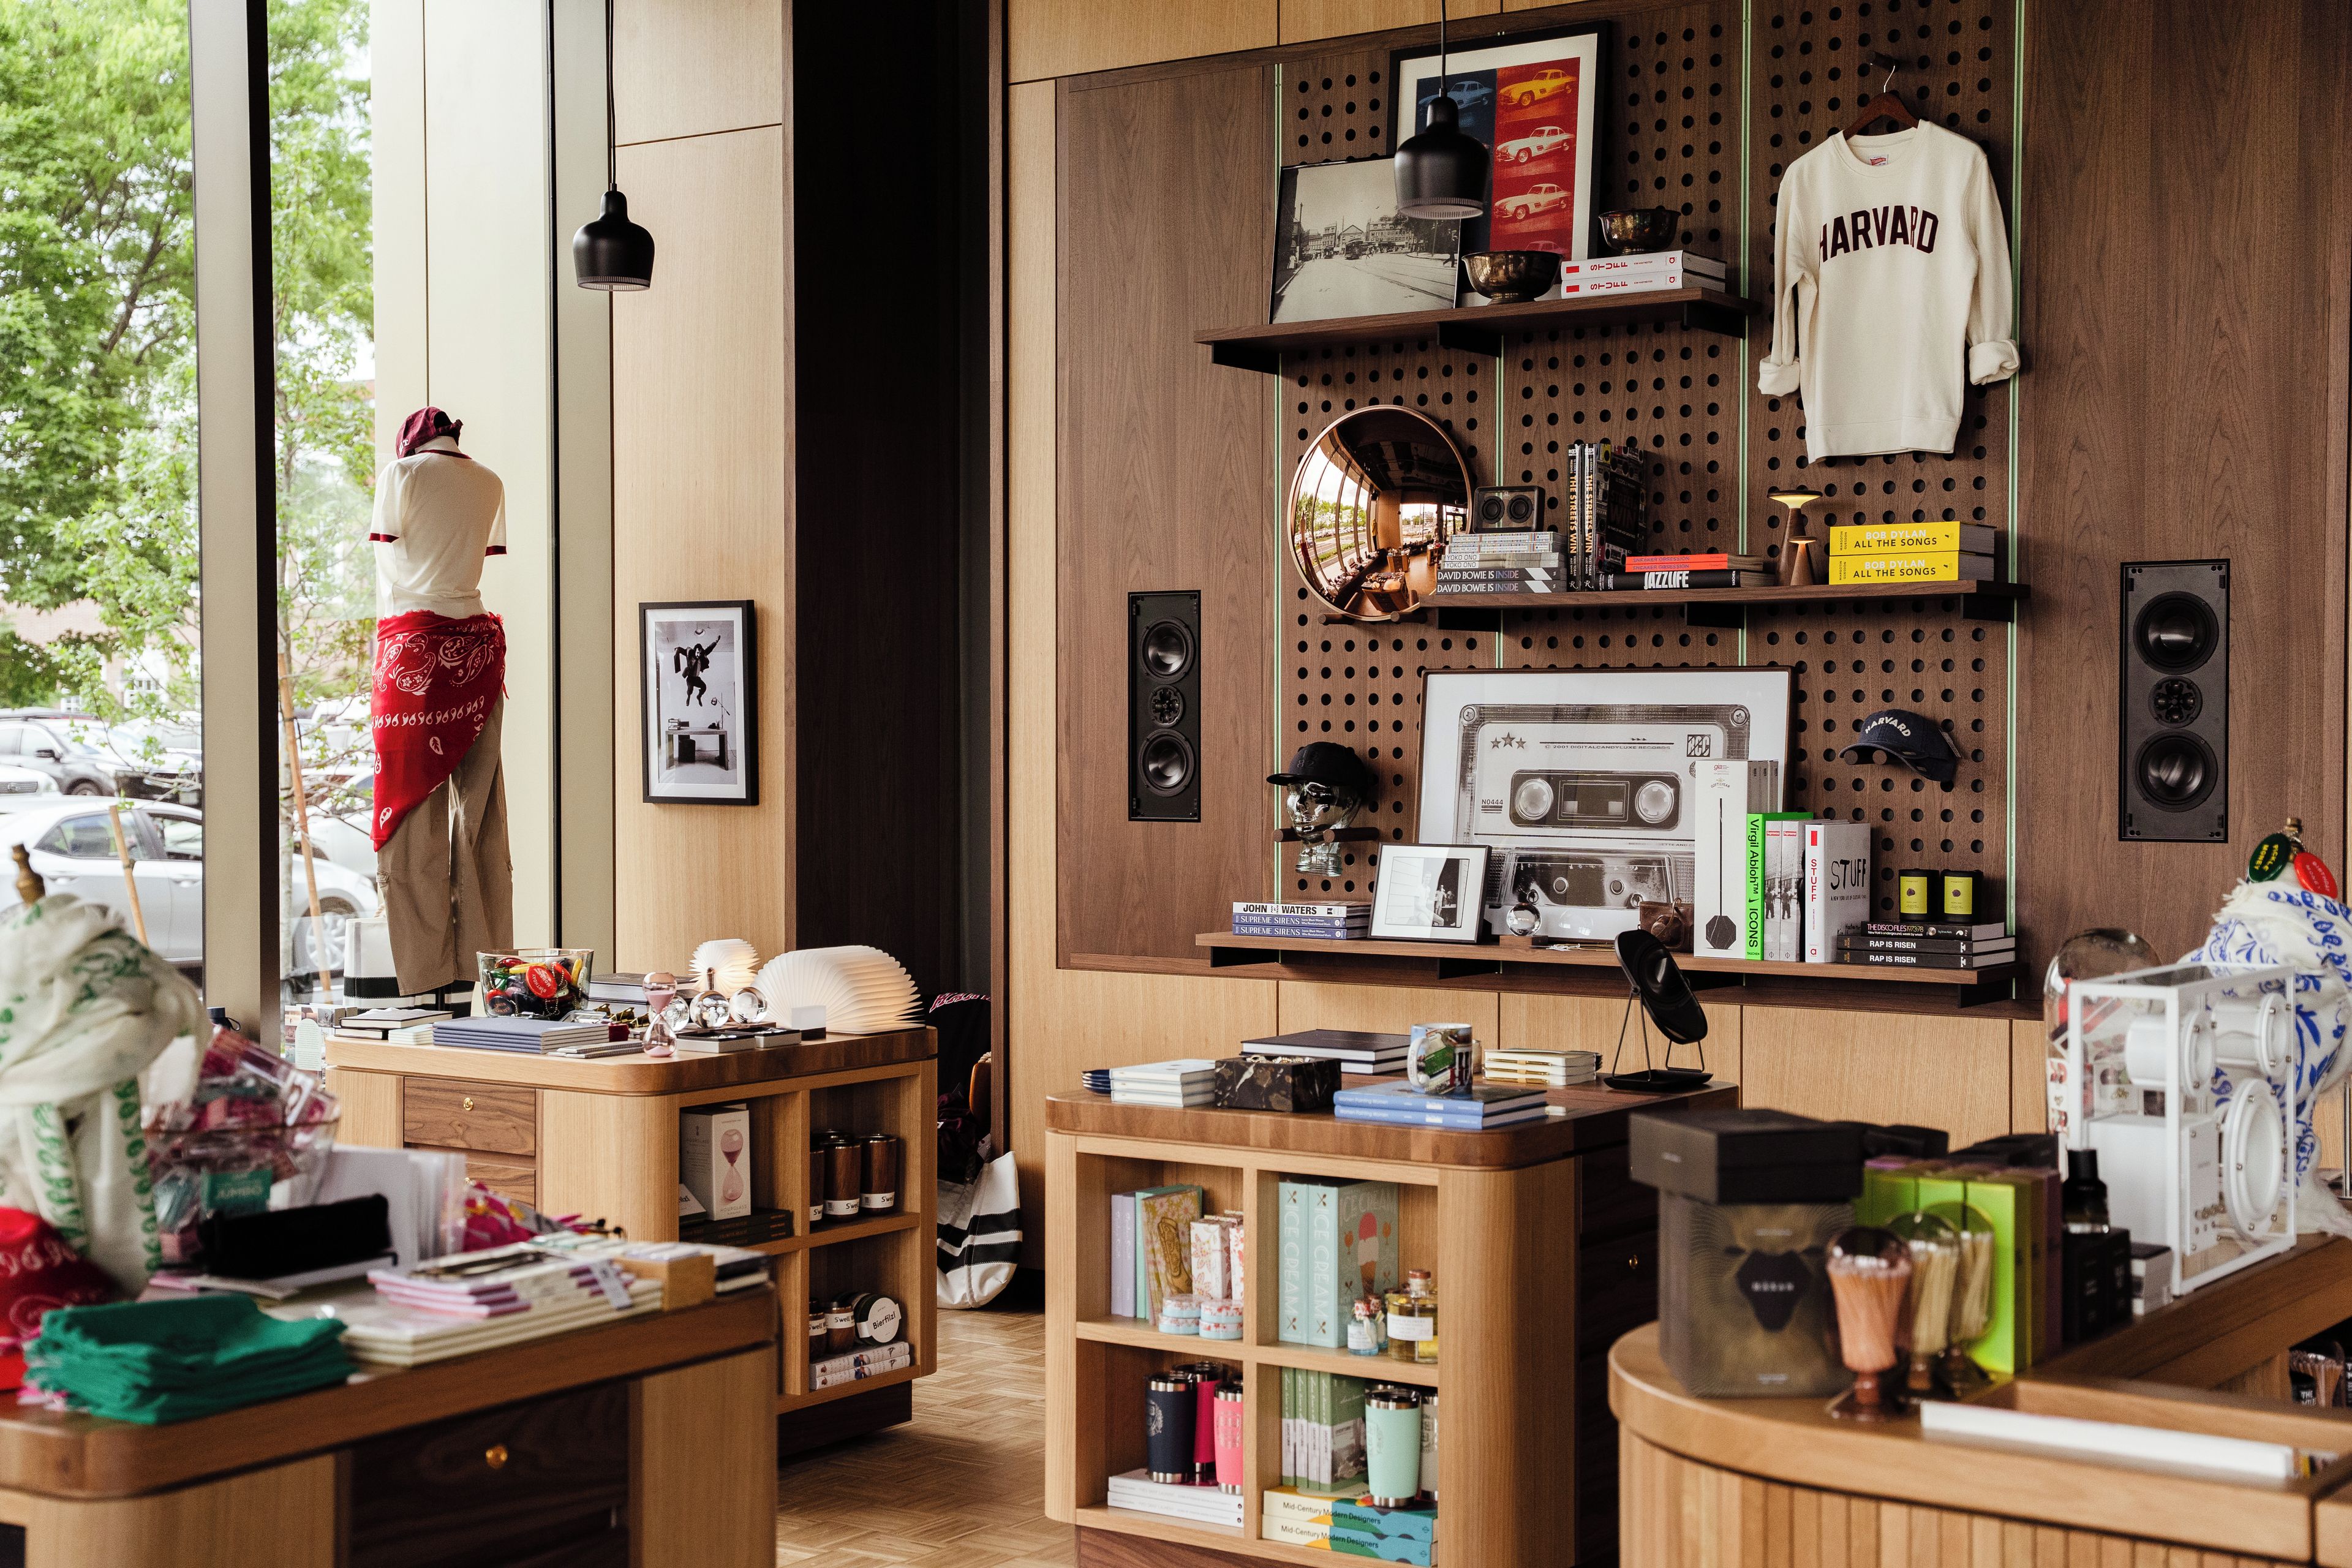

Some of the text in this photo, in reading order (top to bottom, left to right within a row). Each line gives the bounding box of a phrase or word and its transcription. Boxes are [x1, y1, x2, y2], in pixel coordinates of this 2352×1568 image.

[1819, 205, 1939, 265] HARVARD
[1591, 262, 1628, 271] STUFF
[1591, 281, 1628, 290] STUFF
[1891, 529, 1926, 538] DYLAN
[1901, 537, 1937, 546] SONGS
[1890, 559, 1925, 568] DYLAN
[1900, 567, 1936, 576] SONGS
[1462, 571, 1487, 579] BOWIE
[1496, 570, 1519, 579] INSIDE
[1644, 570, 1689, 590] JAZZLIFE
[1865, 717, 1911, 737] HARVARD
[1747, 818, 1759, 848] Virgil
[2253, 845, 2269, 870] MONEY
[2263, 844, 2278, 872] PICKLE
[1831, 859, 1866, 890] STUFF
[2312, 861, 2330, 892] BIRTHDAY
[1243, 904, 1267, 913] JOHN
[1282, 905, 1317, 914] WATERS
[1274, 916, 1300, 925] SIRENS
[1749, 908, 1758, 948] ICONS
[532, 974, 546, 993] BIRTHDAY
[1284, 1205, 1299, 1315] ICE CREAM
[1314, 1208, 1329, 1319] ICE CREAM
[873, 1311, 896, 1330] Bierfilzl
[1283, 1502, 1381, 1525] Mid-Century Modern Designers
[1281, 1526, 1379, 1548] Mid-Century Modern Designers
